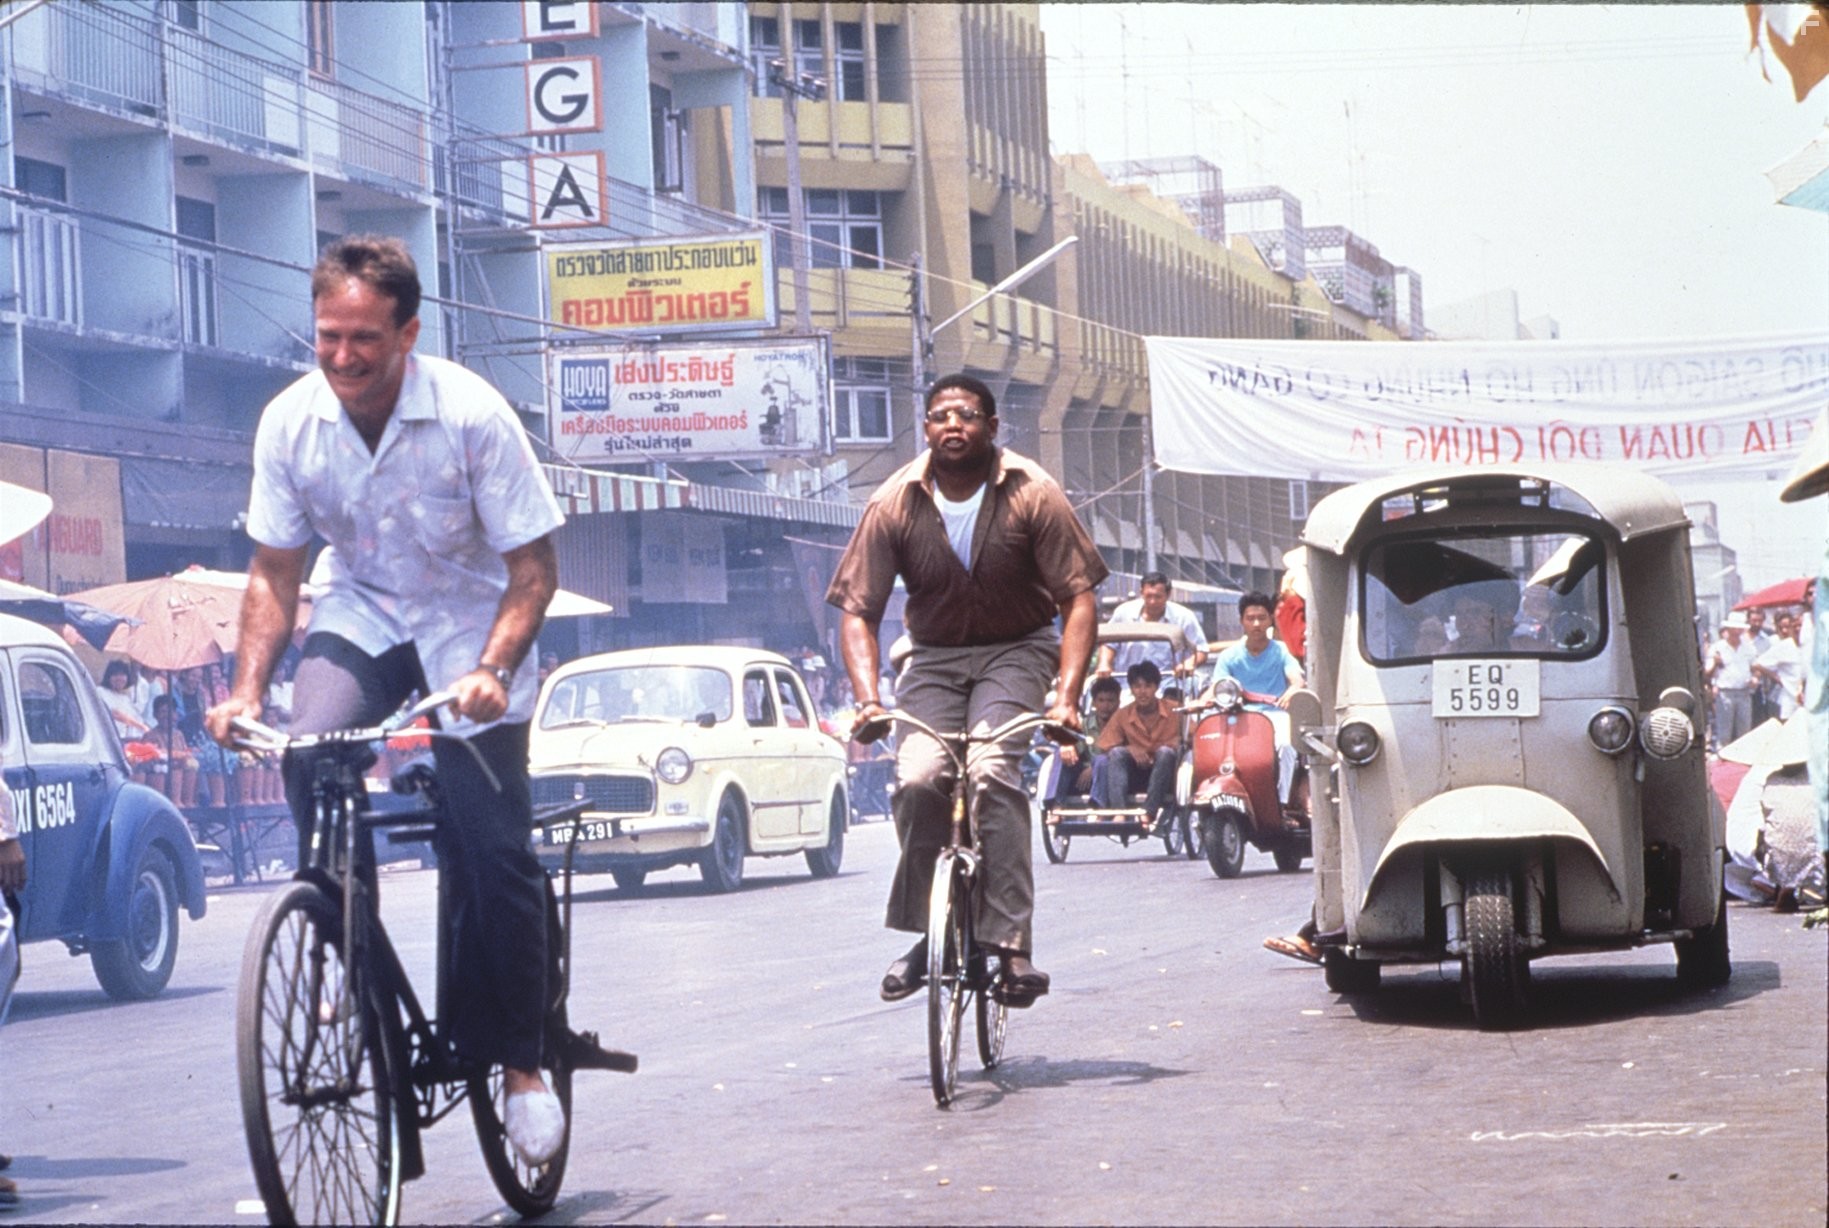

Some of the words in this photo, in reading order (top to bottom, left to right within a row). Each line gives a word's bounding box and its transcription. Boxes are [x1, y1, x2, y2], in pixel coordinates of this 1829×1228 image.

[556, 241, 757, 277] ตรวจวัดสายตาประกอบแว่น
[562, 281, 752, 326] คอมพิวเตอร์
[564, 365, 606, 397] HOYA
[1468, 664, 1503, 685] EQ
[1451, 688, 1519, 711] 5599
[35, 781, 76, 830] 6564
[586, 822, 613, 840] 291
